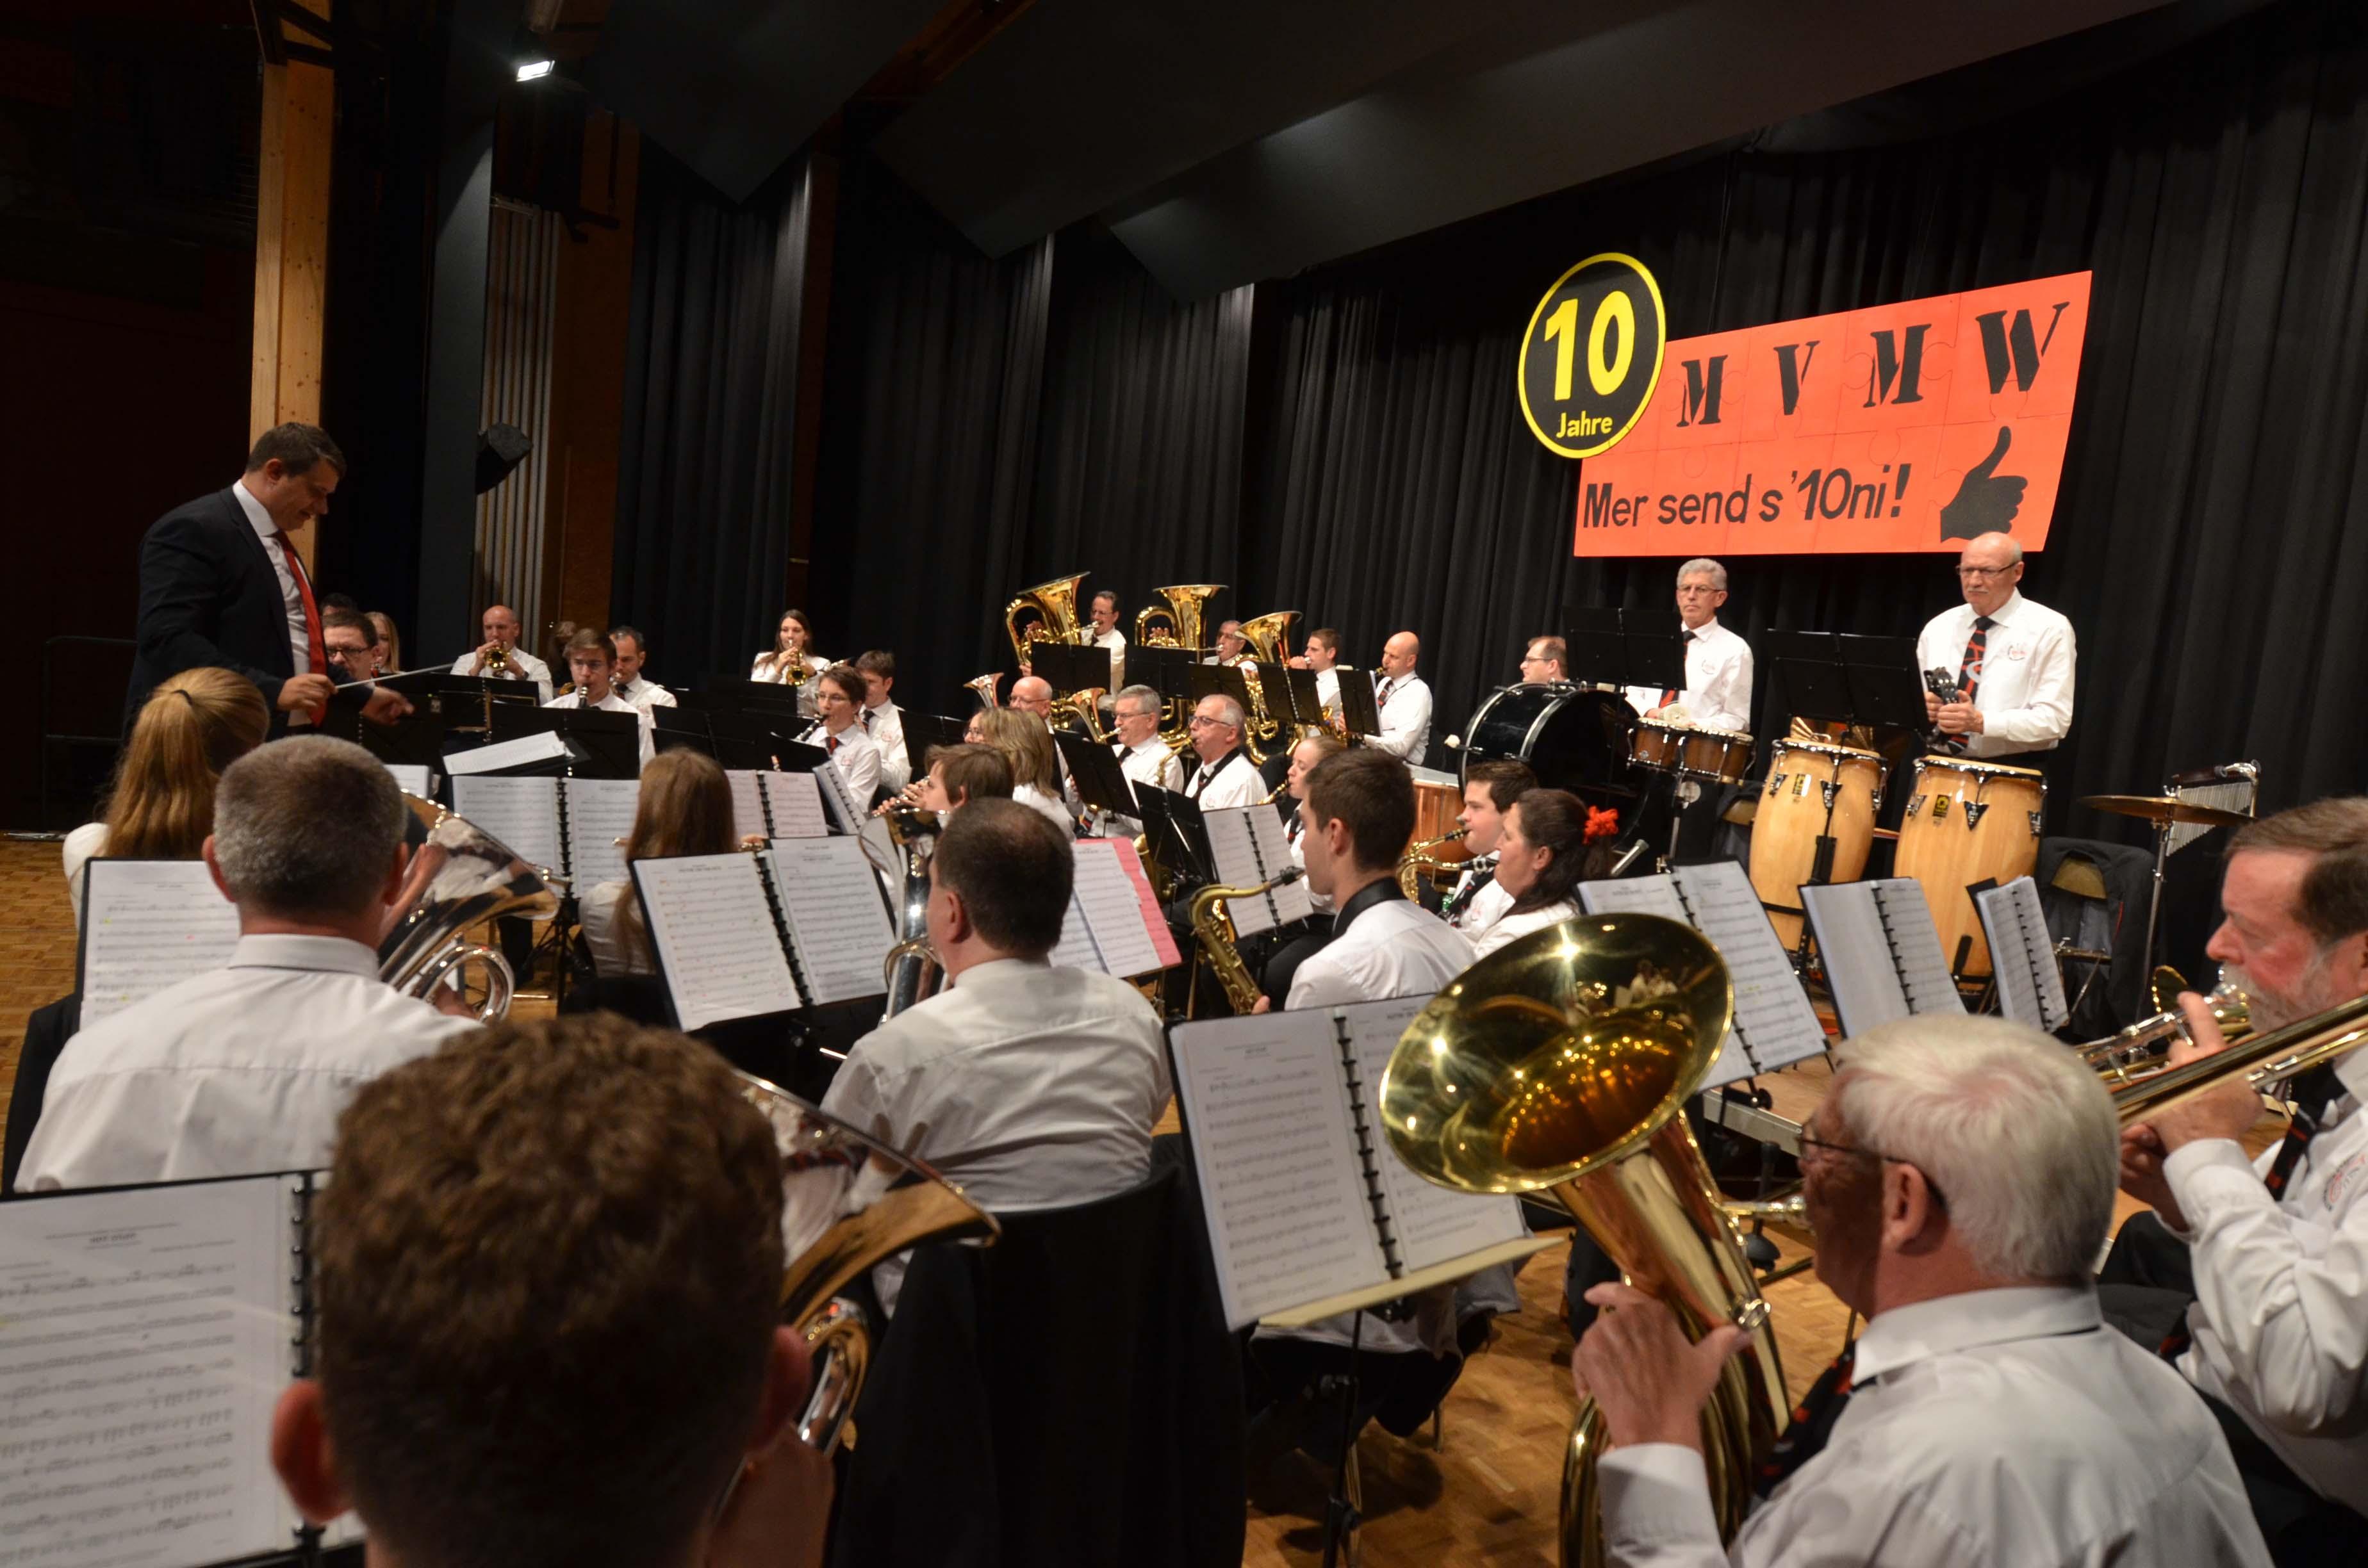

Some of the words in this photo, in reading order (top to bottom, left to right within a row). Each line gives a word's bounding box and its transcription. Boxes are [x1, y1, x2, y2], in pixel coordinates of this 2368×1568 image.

[1544, 290, 1636, 401] 10
[1556, 410, 1613, 439] Jahre
[1583, 482, 1649, 528] Mer
[1657, 474, 1752, 525] send
